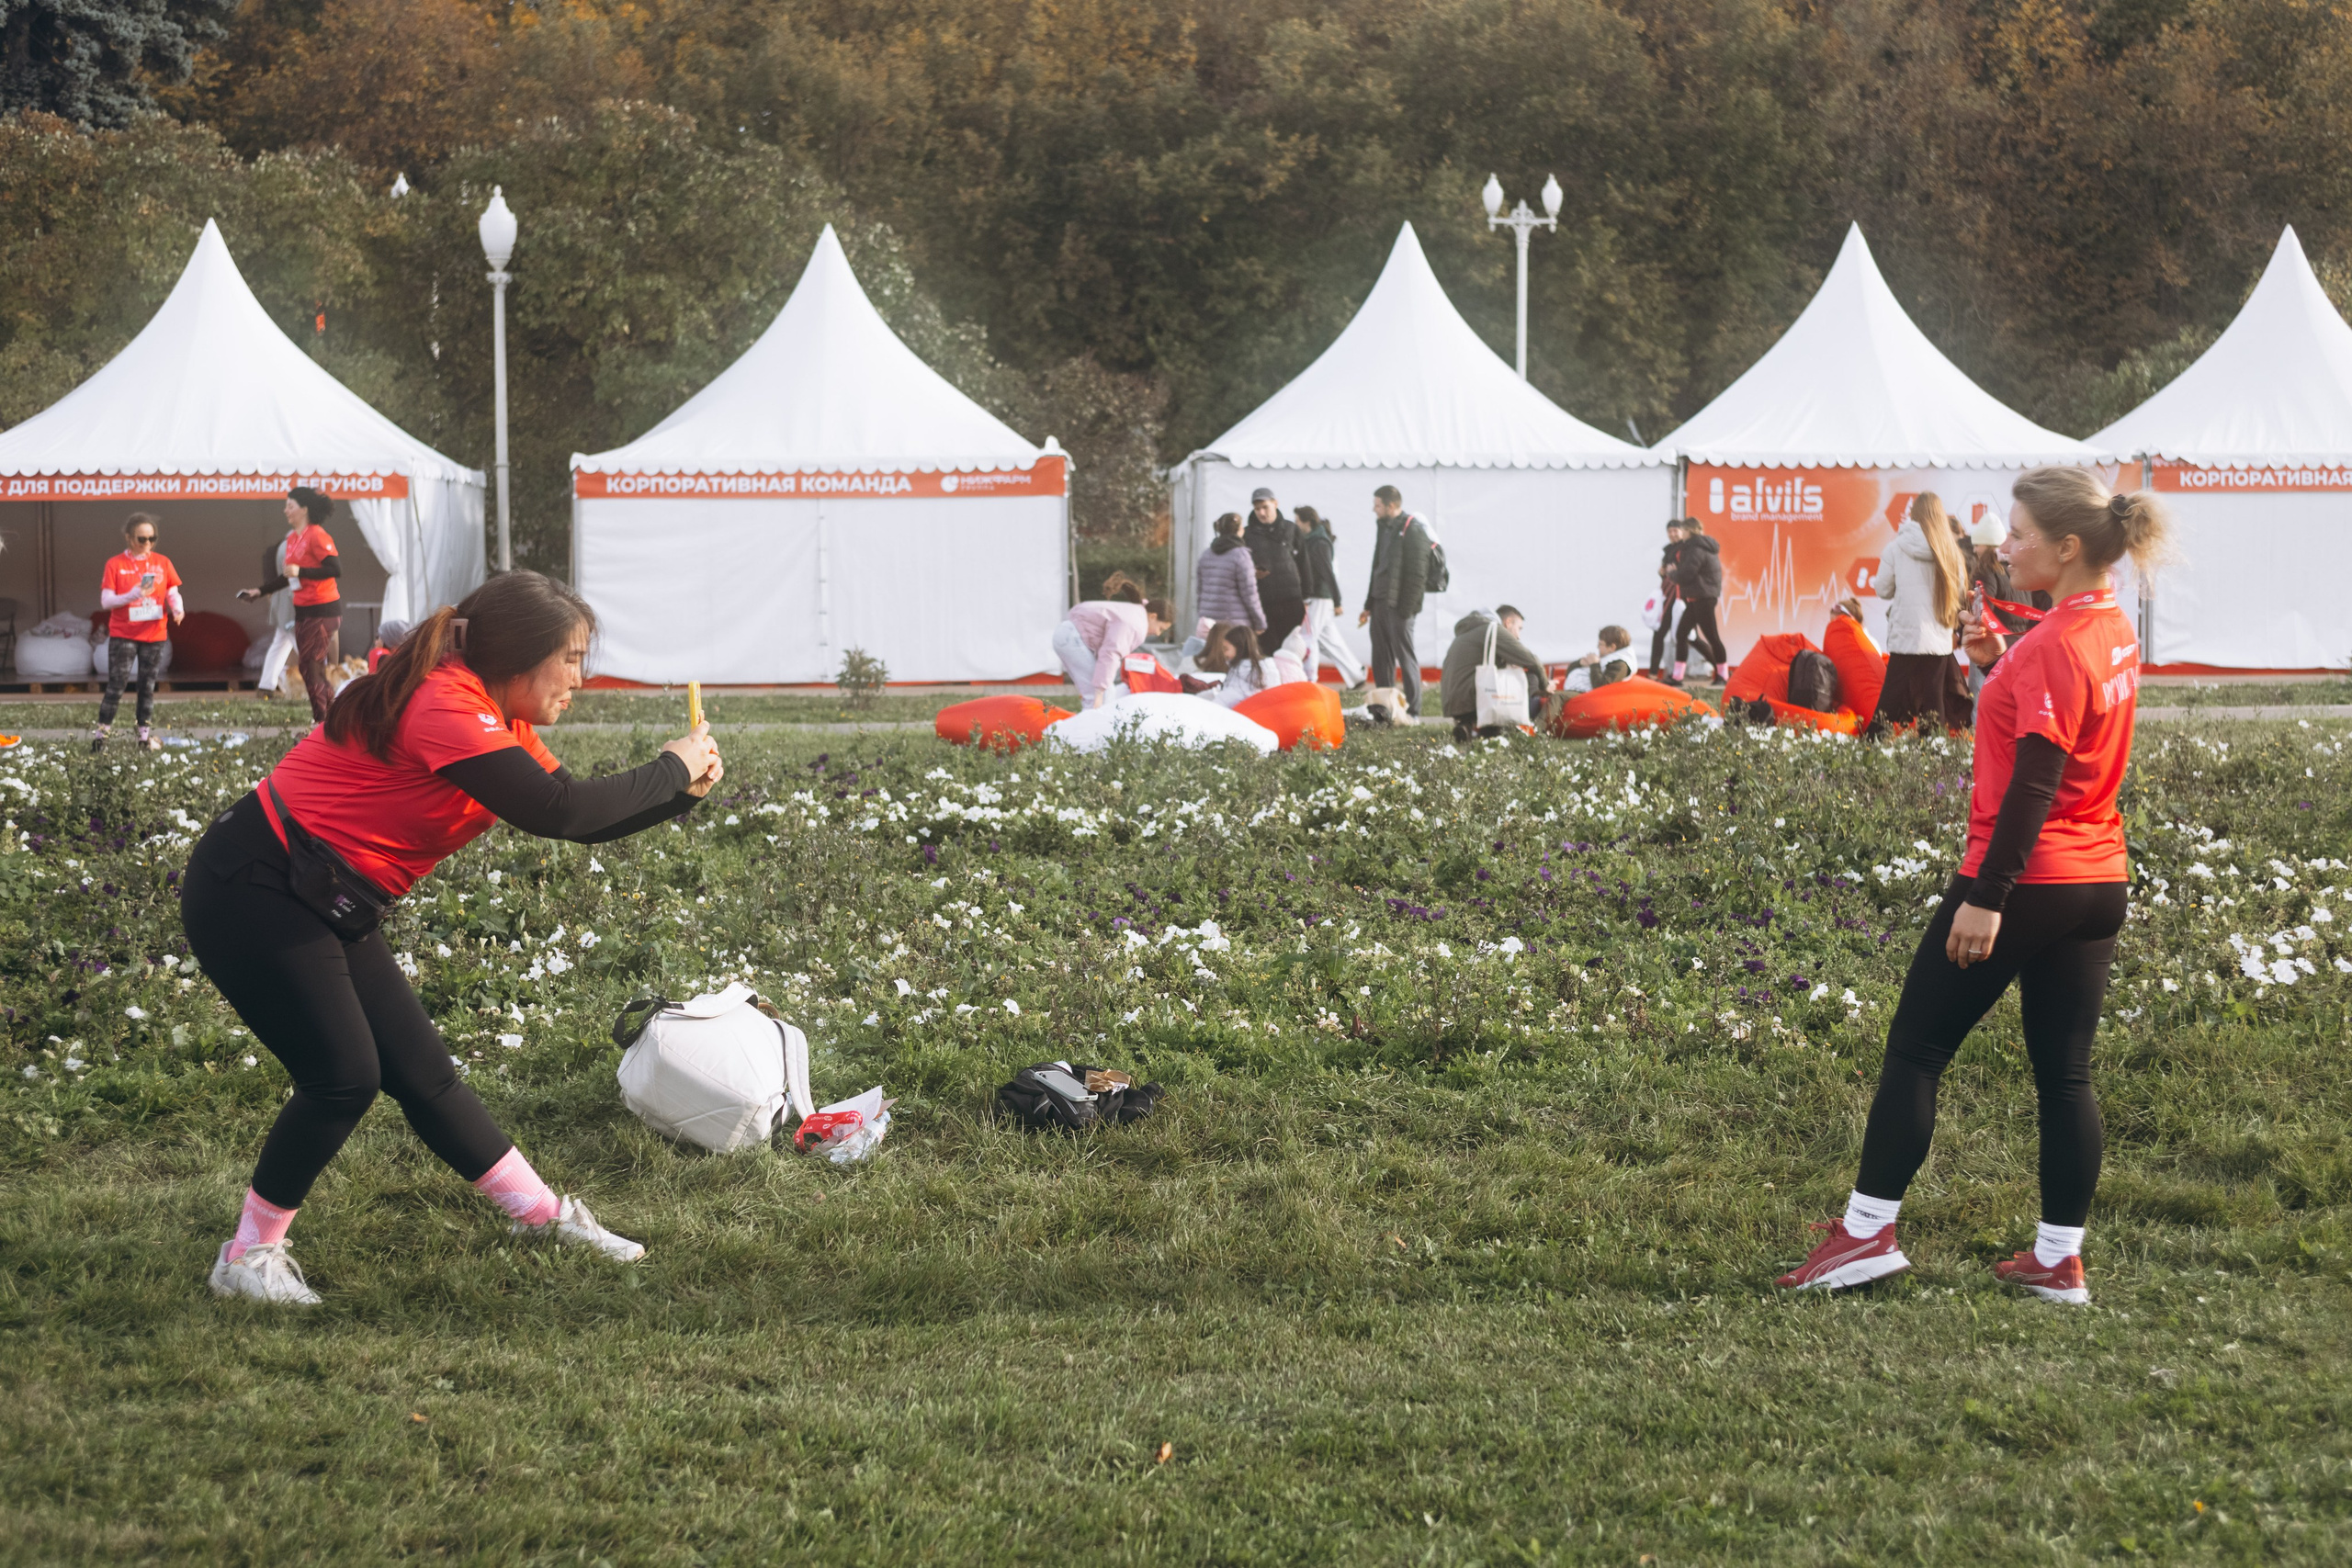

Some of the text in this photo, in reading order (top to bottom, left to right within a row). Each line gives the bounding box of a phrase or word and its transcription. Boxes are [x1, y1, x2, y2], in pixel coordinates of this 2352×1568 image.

[7, 479, 49, 496] ДЛЯ
[54, 479, 181, 496] ПОДДЕРЖКИ
[186, 478, 291, 493] ЛЮБИМЫХ
[297, 477, 384, 492] БЕГУНОВ
[606, 476, 912, 494] КОРПОРАТИВНАЯ КОМАНДА
[2179, 469, 2352, 487] КОРПОРАТИВНАЯ
[1731, 513, 1824, 524] brand management
